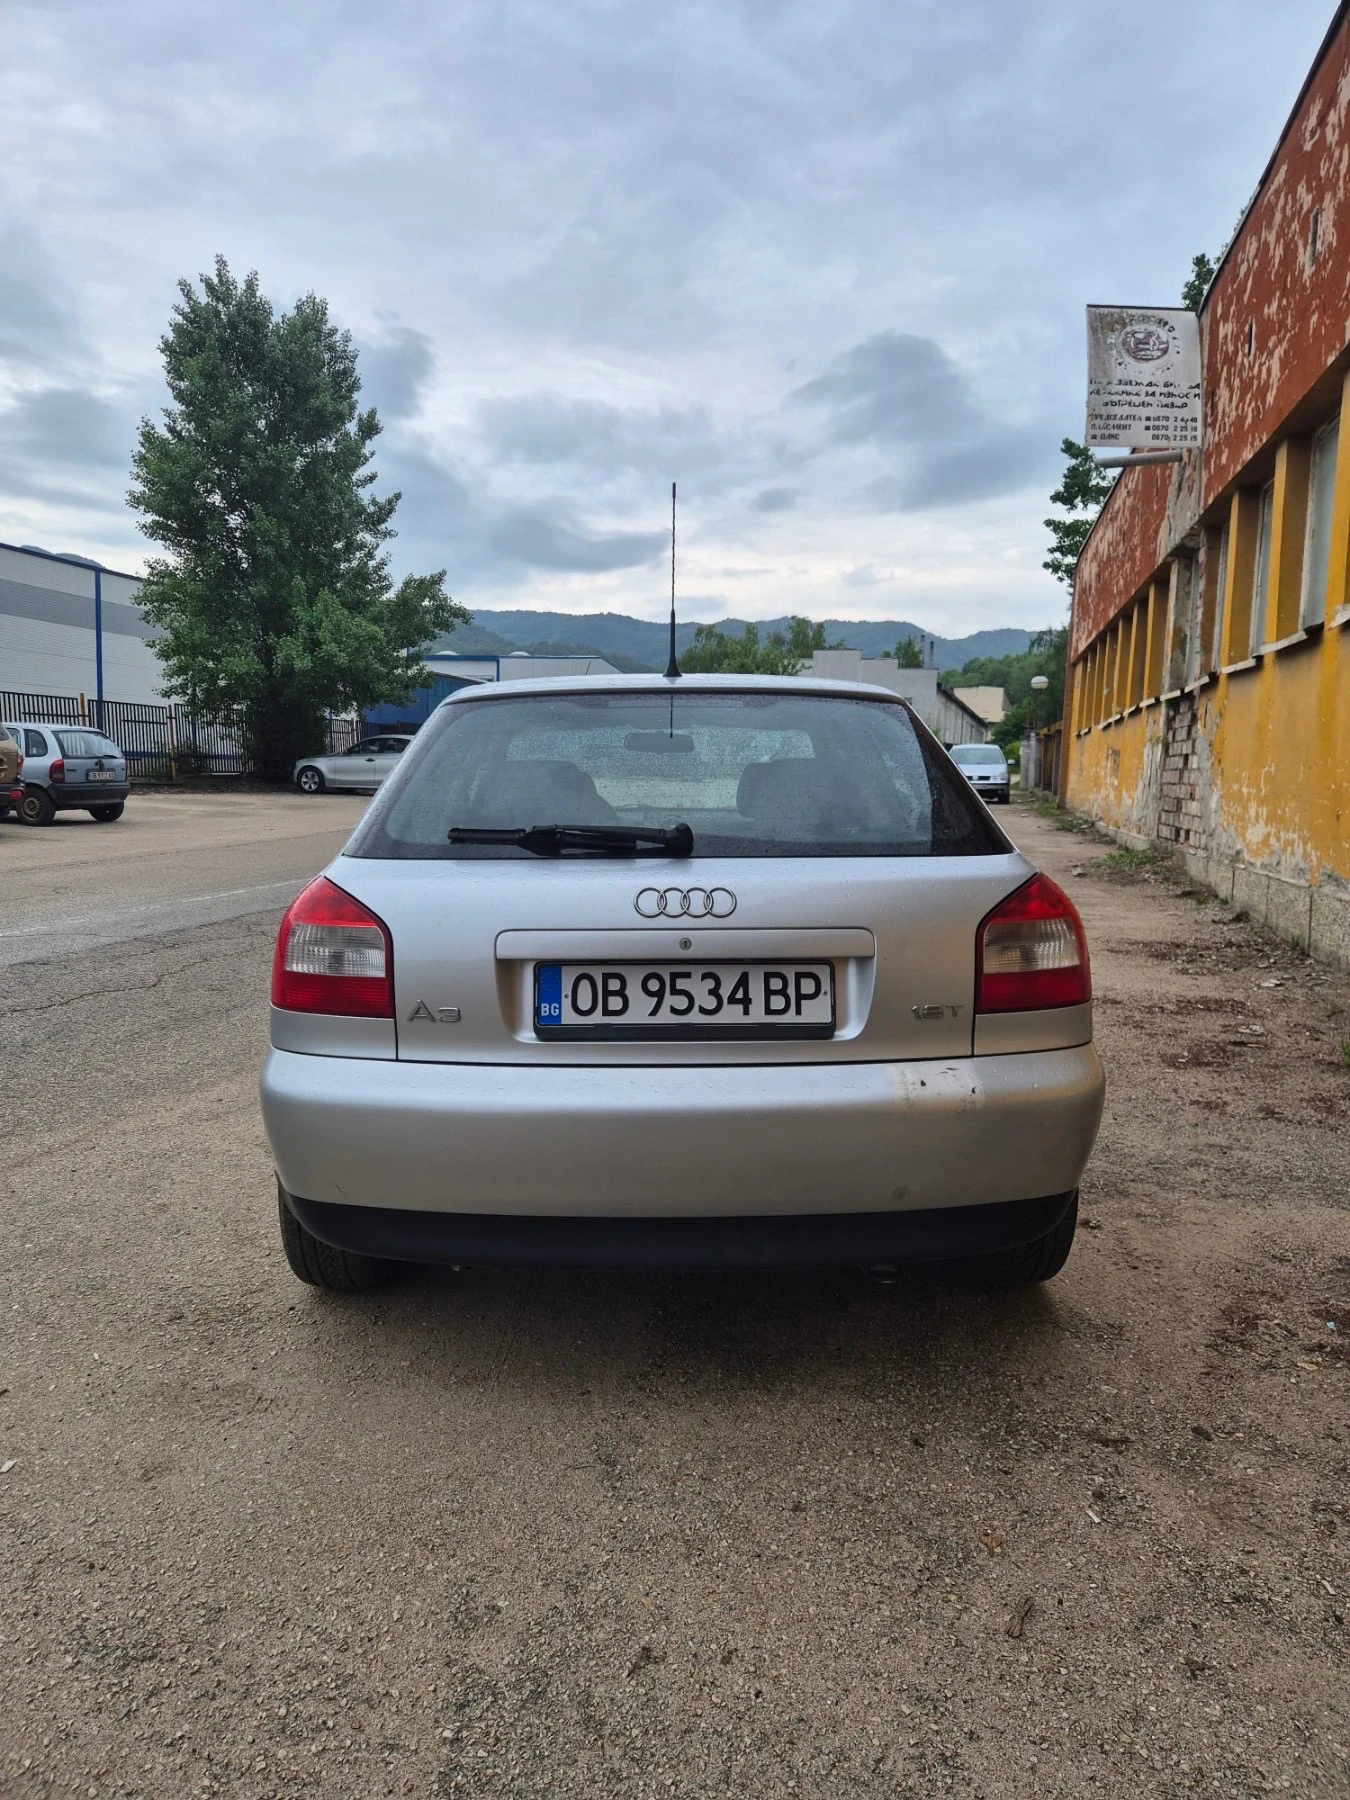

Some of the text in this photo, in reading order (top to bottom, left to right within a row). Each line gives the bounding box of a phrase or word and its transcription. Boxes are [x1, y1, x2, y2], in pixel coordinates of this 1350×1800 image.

[1144, 390, 1155, 398] ЗА
[1193, 392, 1200, 400] И
[1173, 424, 1178, 432] 2
[640, 971, 753, 1017] 9534
[763, 971, 822, 1016] BP
[407, 999, 461, 1023] A3
[540, 1003, 560, 1016] BG
